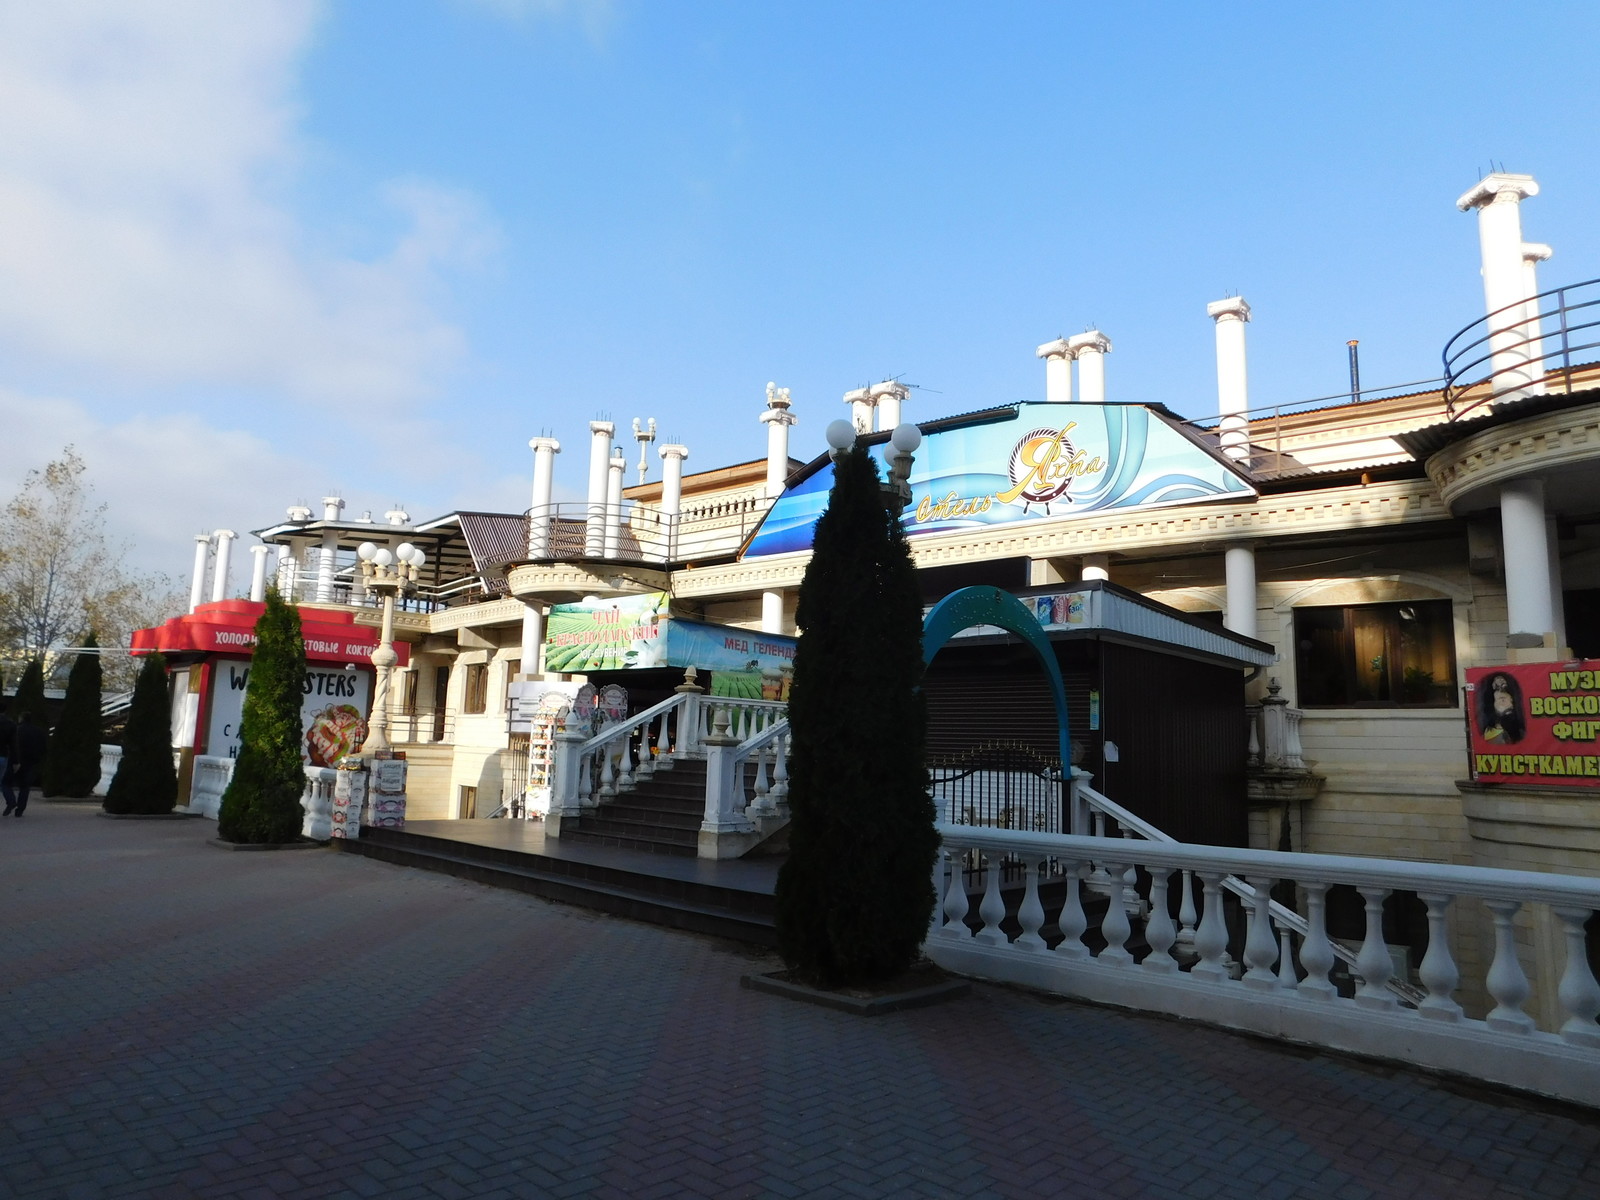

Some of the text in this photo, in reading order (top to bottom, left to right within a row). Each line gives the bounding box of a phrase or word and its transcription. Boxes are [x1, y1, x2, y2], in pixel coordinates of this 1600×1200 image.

[996, 421, 1105, 503] Яхта
[917, 491, 992, 521] Отель
[592, 608, 621, 625] ЧАЙ
[555, 624, 659, 647] КРАСНОДАРСКИЙ
[724, 637, 749, 654] МЕД
[1530, 695, 1600, 715] ВОСКО
[1476, 754, 1600, 776] КУНСТКАМЕ
